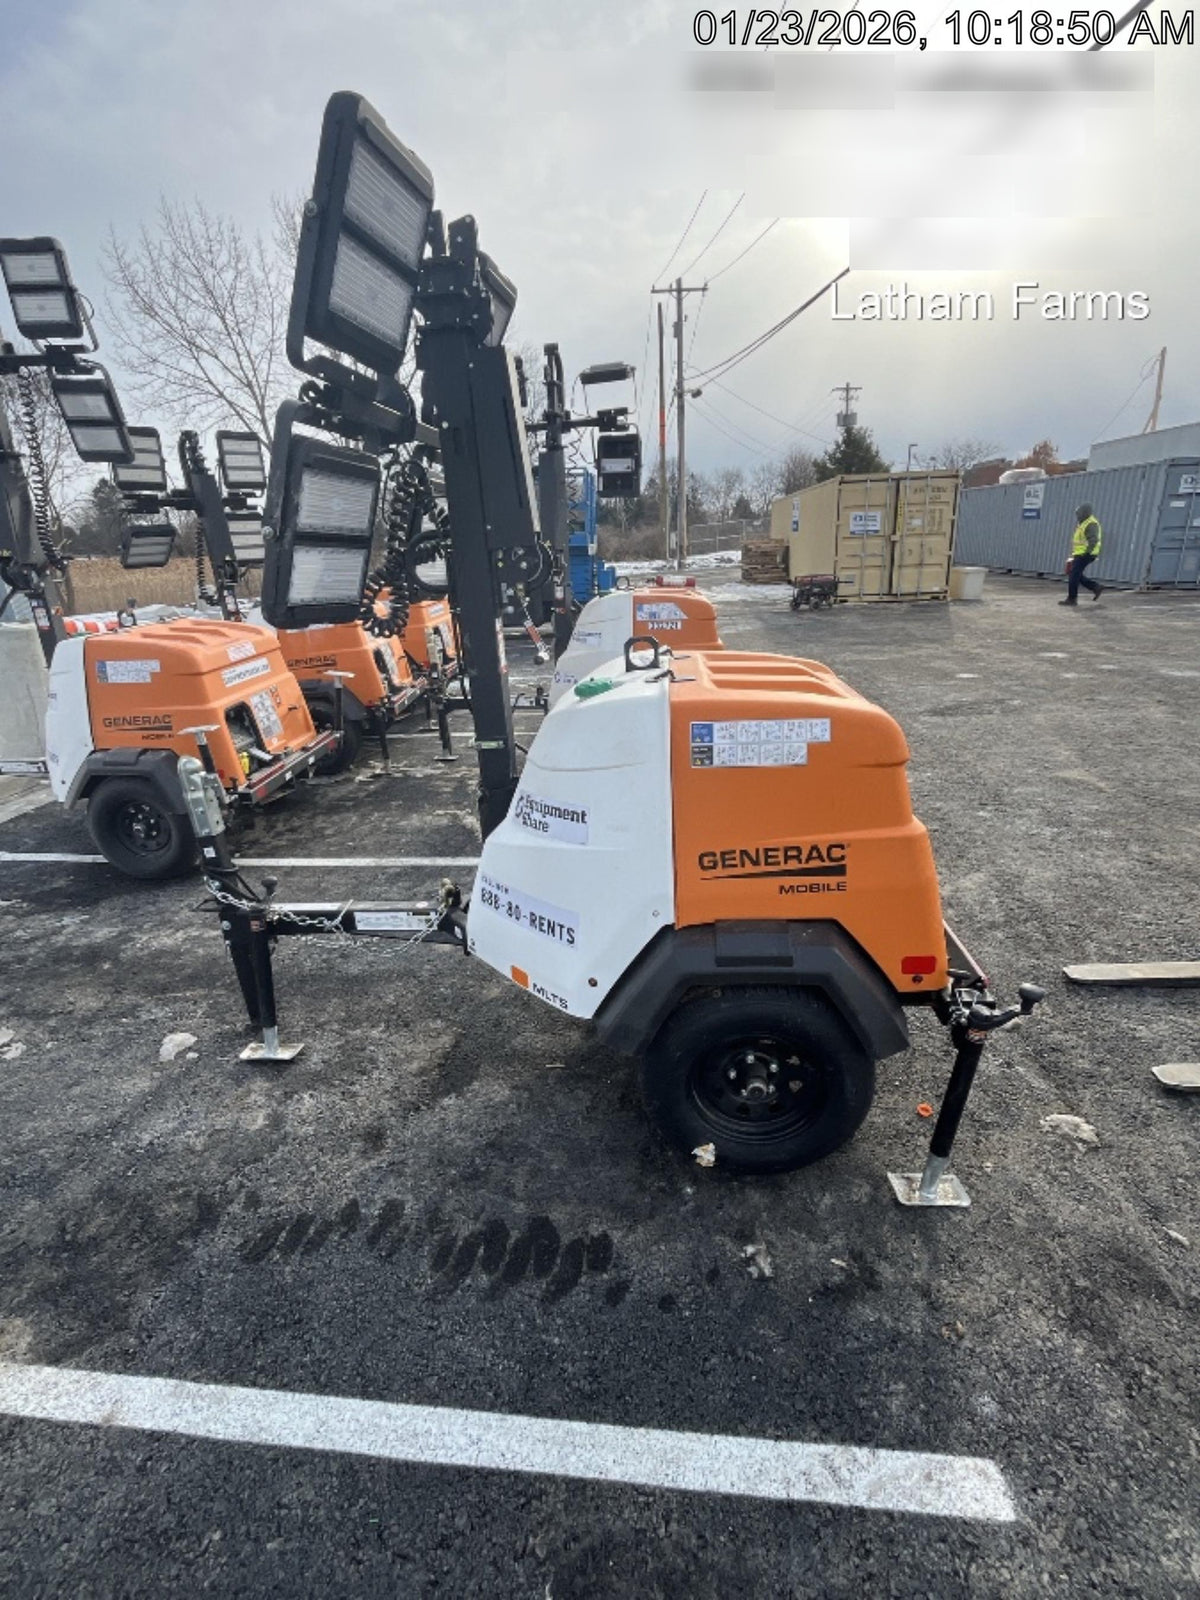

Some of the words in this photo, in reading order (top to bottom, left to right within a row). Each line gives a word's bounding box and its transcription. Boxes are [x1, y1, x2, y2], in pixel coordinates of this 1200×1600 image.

[102, 713, 173, 728] GENERAC
[521, 811, 550, 833] Share
[698, 842, 847, 872] GENERAC
[779, 881, 848, 895] MOBILE
